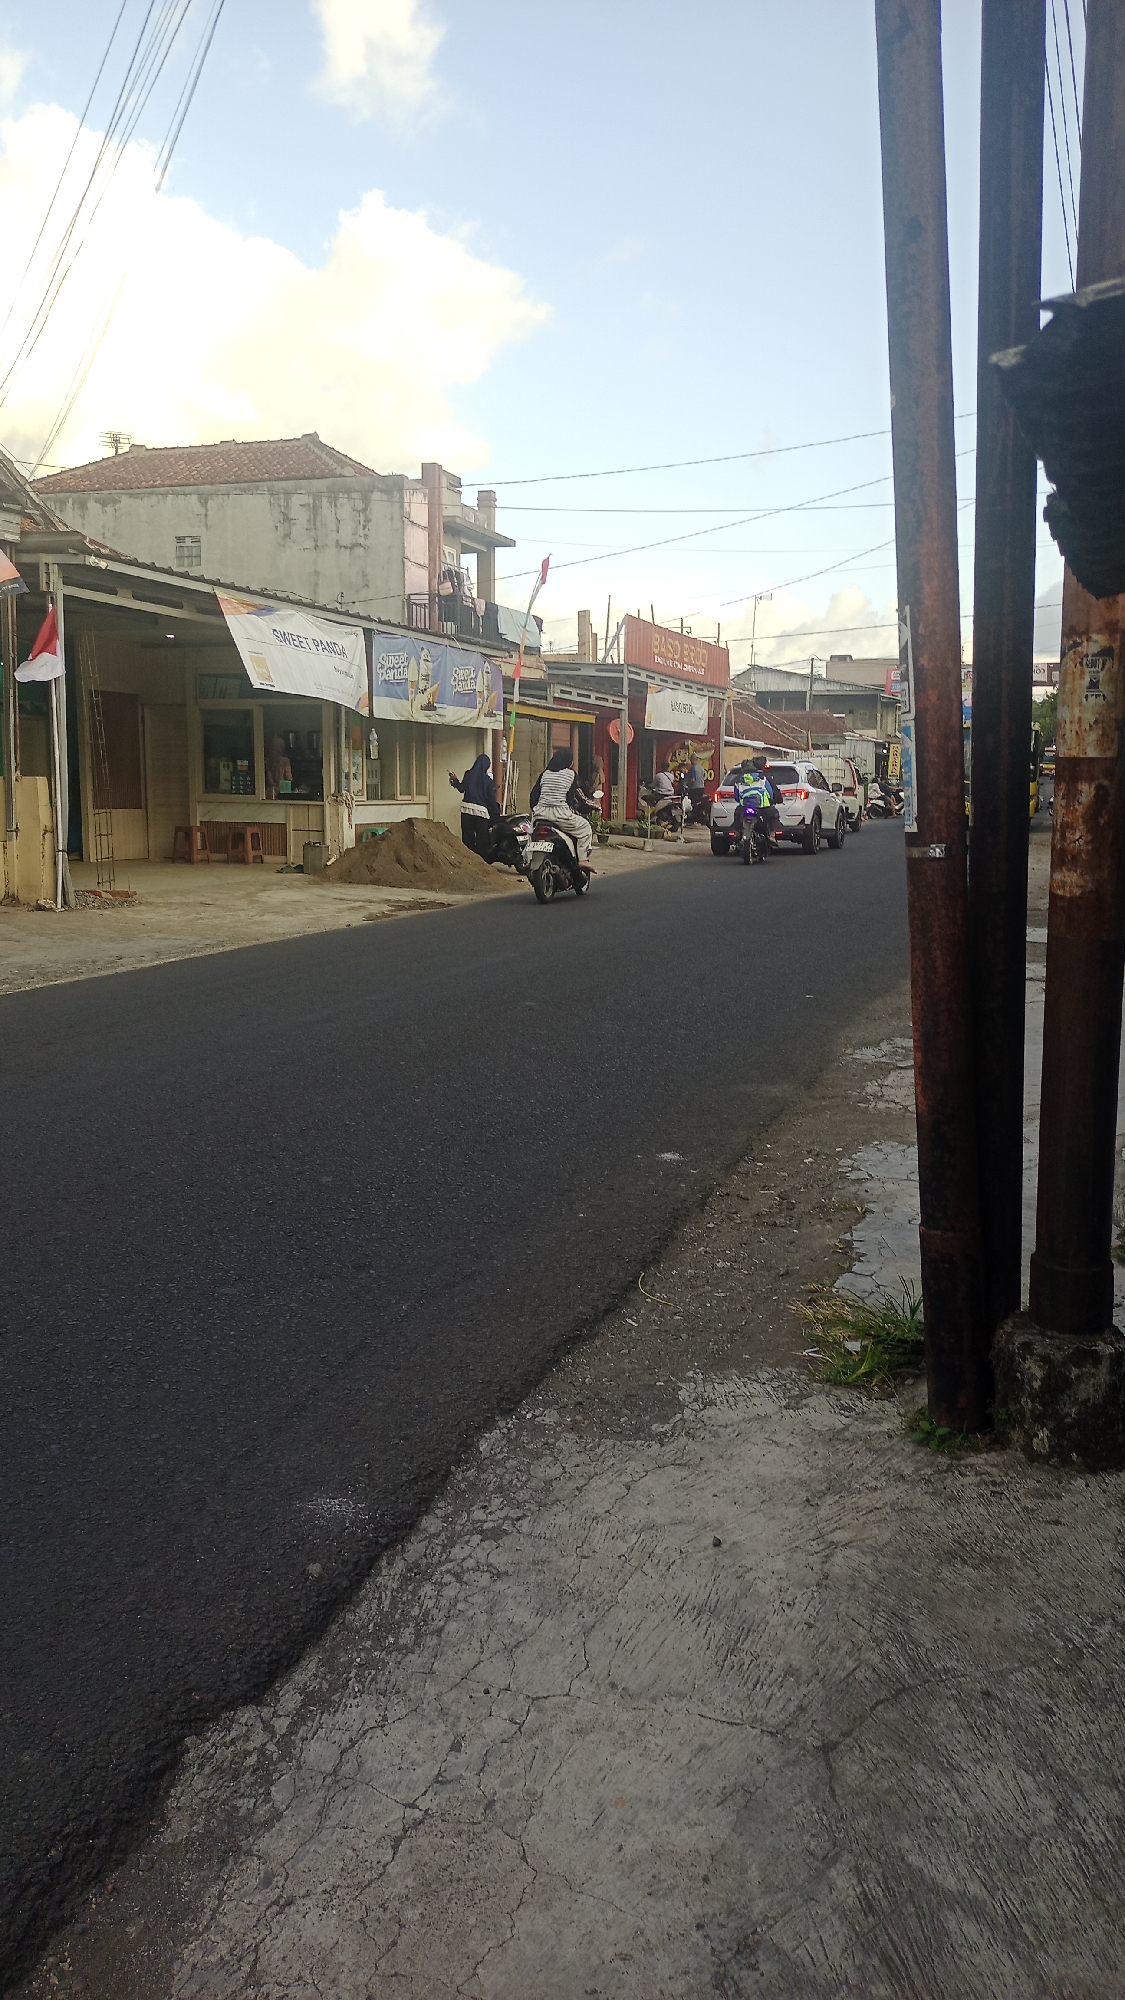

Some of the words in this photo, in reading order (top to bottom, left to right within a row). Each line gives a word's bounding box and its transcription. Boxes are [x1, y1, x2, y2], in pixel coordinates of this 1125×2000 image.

[272, 629, 311, 651] SWEET
[312, 638, 348, 659] PANDA
[653, 633, 680, 660] BASO
[377, 651, 409, 672] Sweet
[451, 666, 476, 685] Sweet
